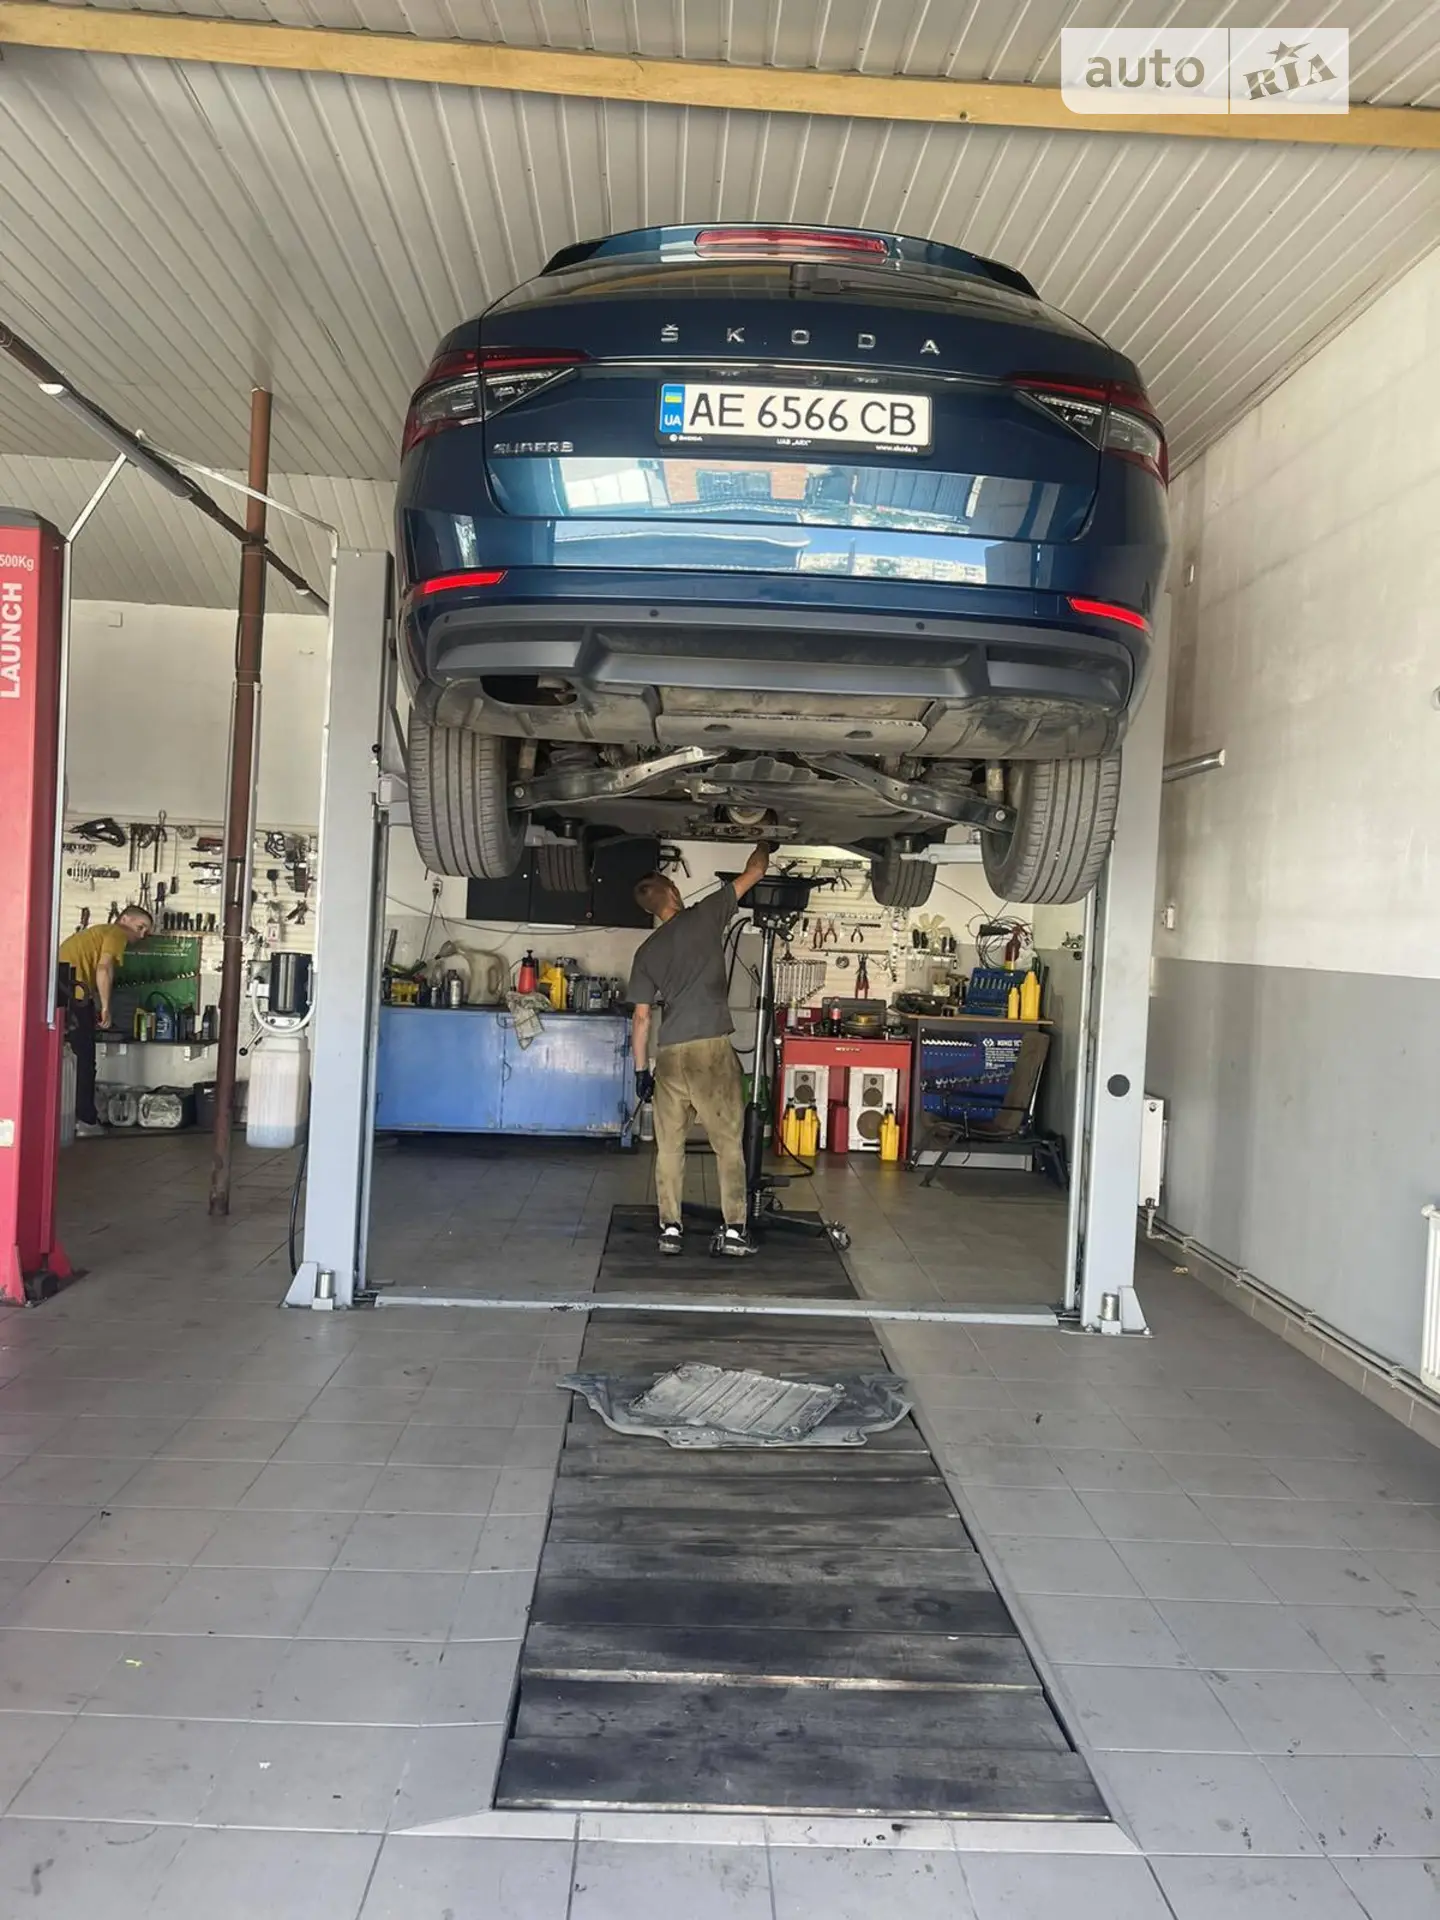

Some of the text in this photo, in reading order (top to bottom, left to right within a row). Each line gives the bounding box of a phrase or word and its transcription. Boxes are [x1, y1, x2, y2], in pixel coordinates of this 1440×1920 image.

[660, 324, 941, 355] ŠKODA
[664, 415, 683, 428] UA
[689, 392, 917, 436] AE 6566 CB
[493, 441, 574, 454] SUPERB
[0, 582, 24, 699] LAUNCH
